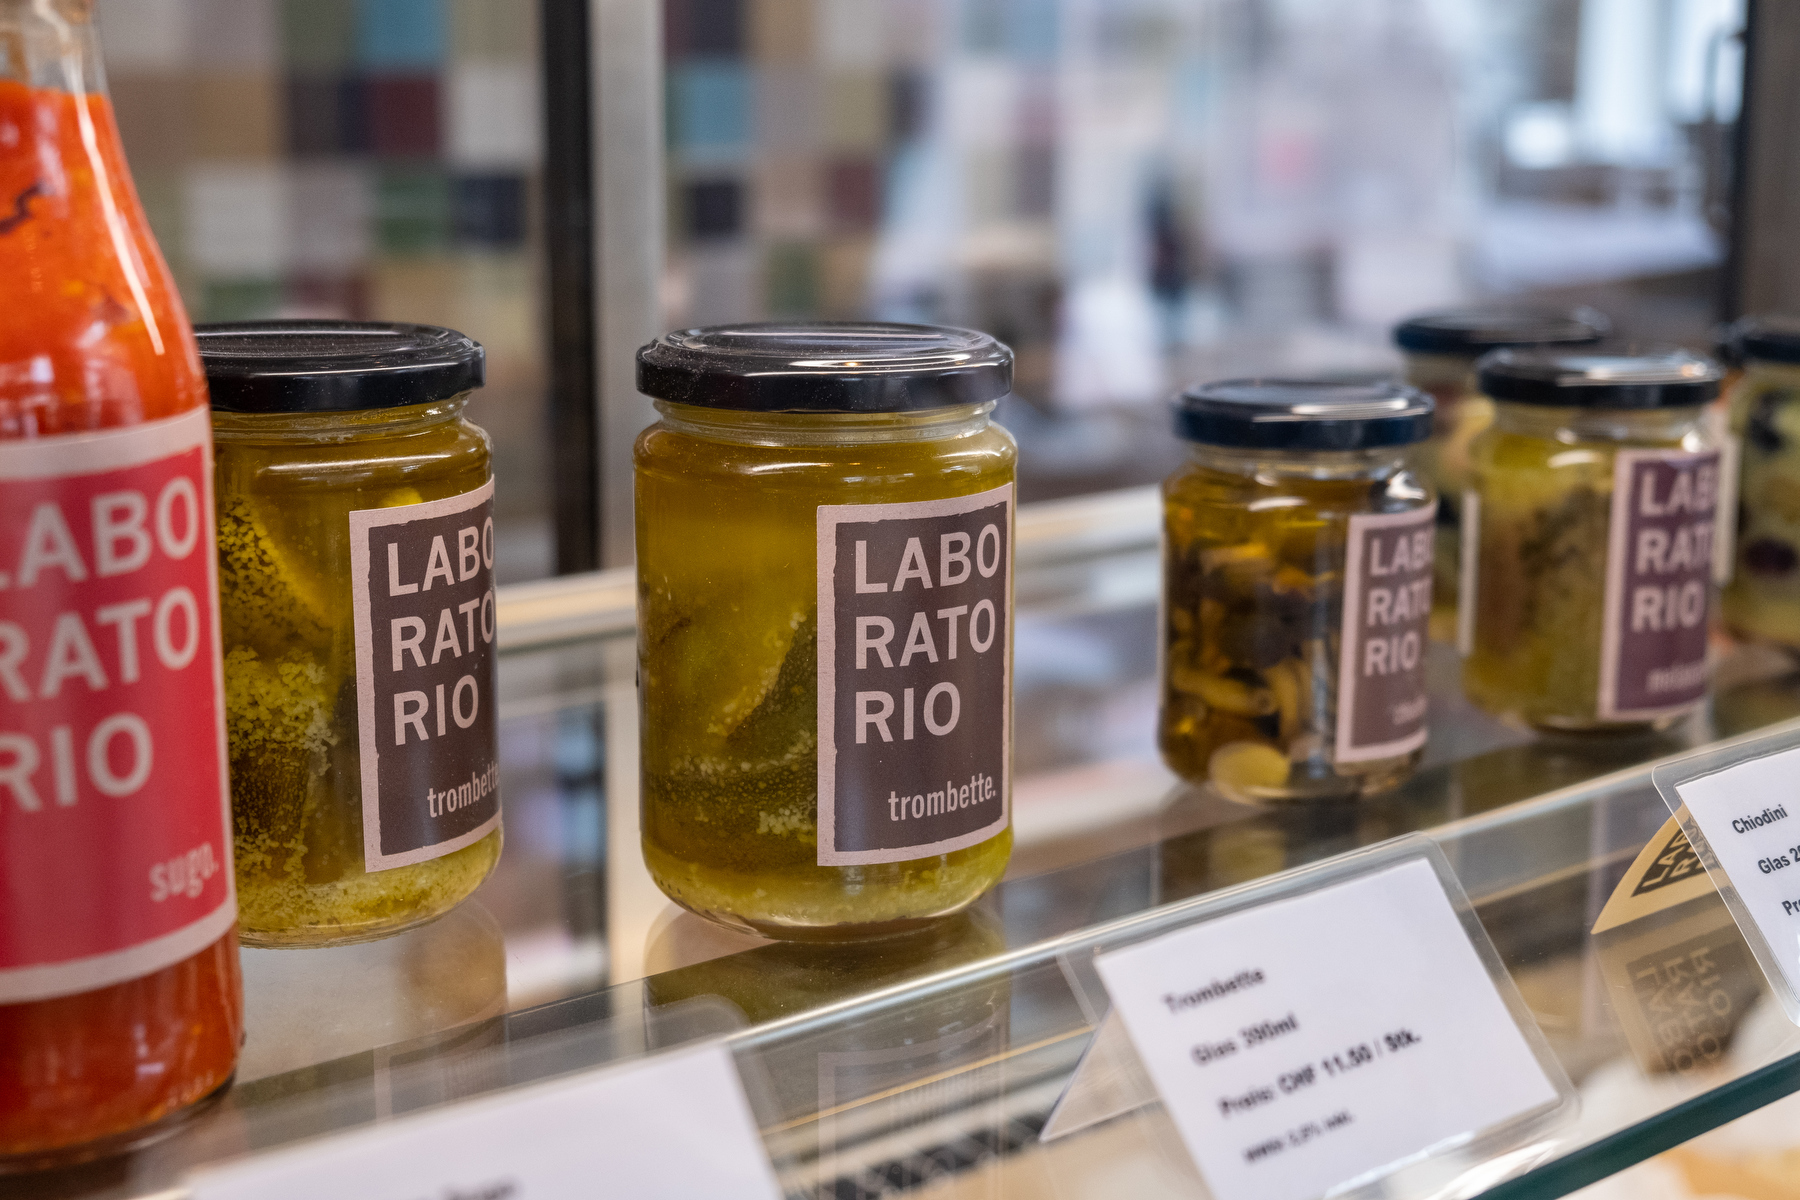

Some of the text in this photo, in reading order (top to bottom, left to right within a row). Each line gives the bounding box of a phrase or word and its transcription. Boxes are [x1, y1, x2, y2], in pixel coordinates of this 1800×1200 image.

[1640, 464, 1717, 517] LAB
[0, 476, 199, 590] ABO
[387, 516, 494, 597] LABO
[855, 523, 1000, 594] LABO
[1635, 522, 1712, 575] RAT
[391, 589, 495, 672] RATO
[855, 599, 996, 670] RATO
[1631, 580, 1704, 632] RIO
[1364, 630, 1420, 677] RIO
[393, 674, 479, 746] RIO
[855, 681, 961, 744] RIO
[0, 712, 154, 812] RIO
[888, 772, 996, 822] trombette.
[1732, 803, 1788, 834] Chiodini
[1758, 855, 1790, 874] Glas
[1164, 968, 1265, 1013] Trombette
[1191, 1039, 1238, 1067] Glas
[1277, 1064, 1317, 1095] CHF
[1322, 1043, 1374, 1077] 11.50
[1384, 1027, 1421, 1053] Stk.
